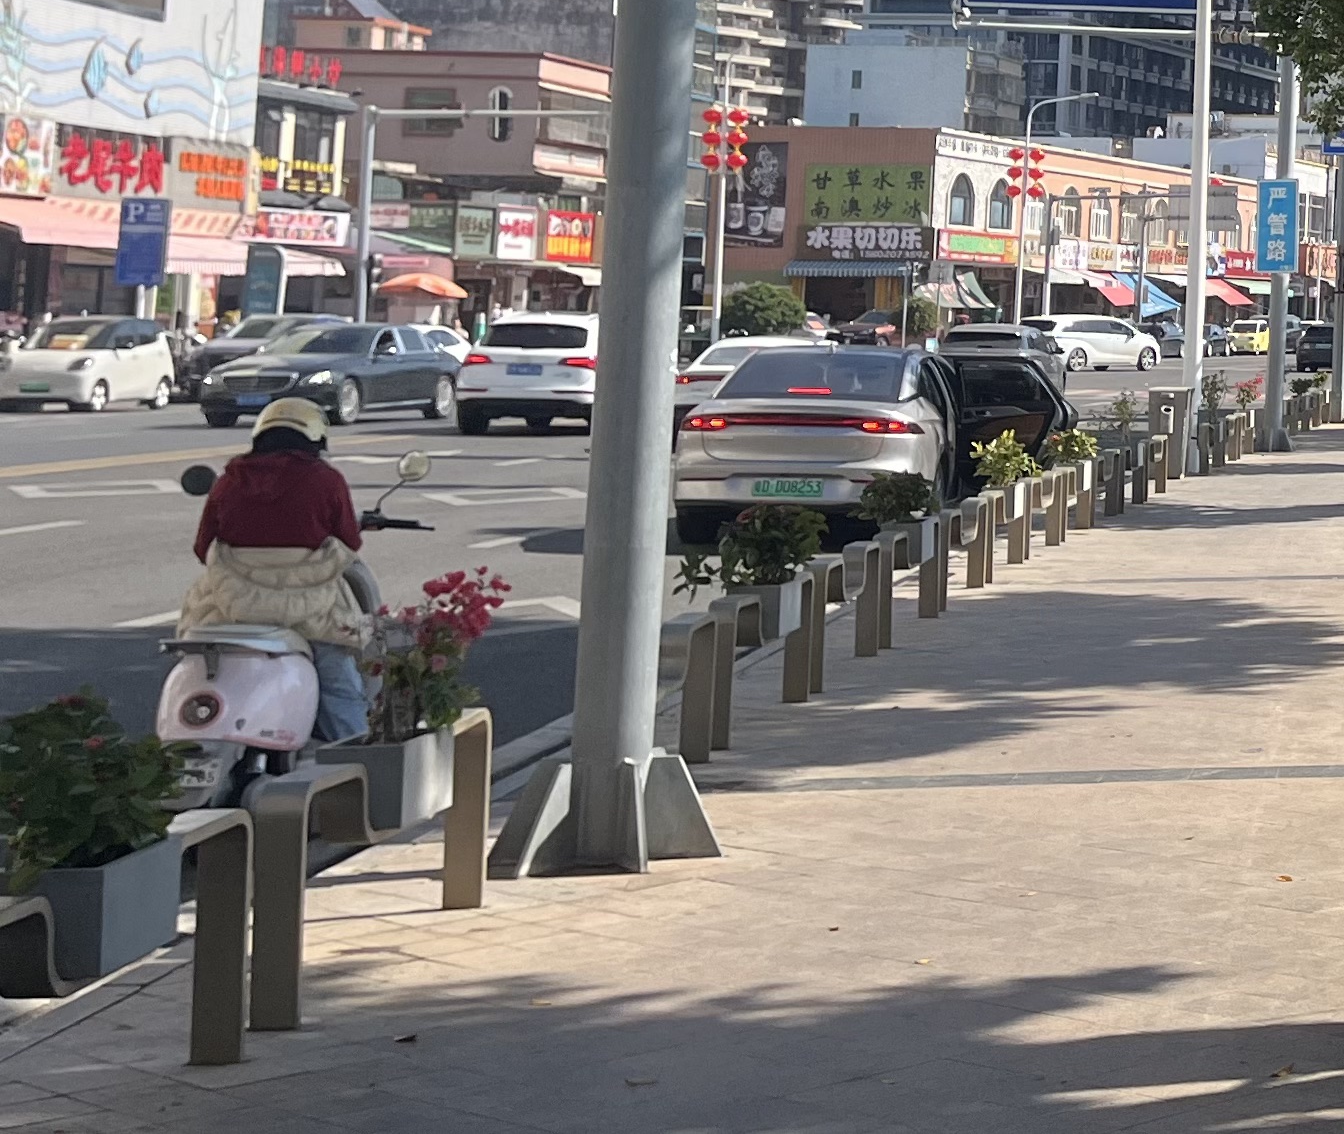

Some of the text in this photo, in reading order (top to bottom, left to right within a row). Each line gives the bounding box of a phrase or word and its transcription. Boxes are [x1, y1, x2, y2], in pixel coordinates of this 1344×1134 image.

[812, 168, 925, 192] 甘草水果
[126, 202, 145, 223] P
[810, 195, 922, 219] 南澳炒冰
[1265, 187, 1288, 262] 严管路
[806, 226, 923, 251] 水果切切乐
